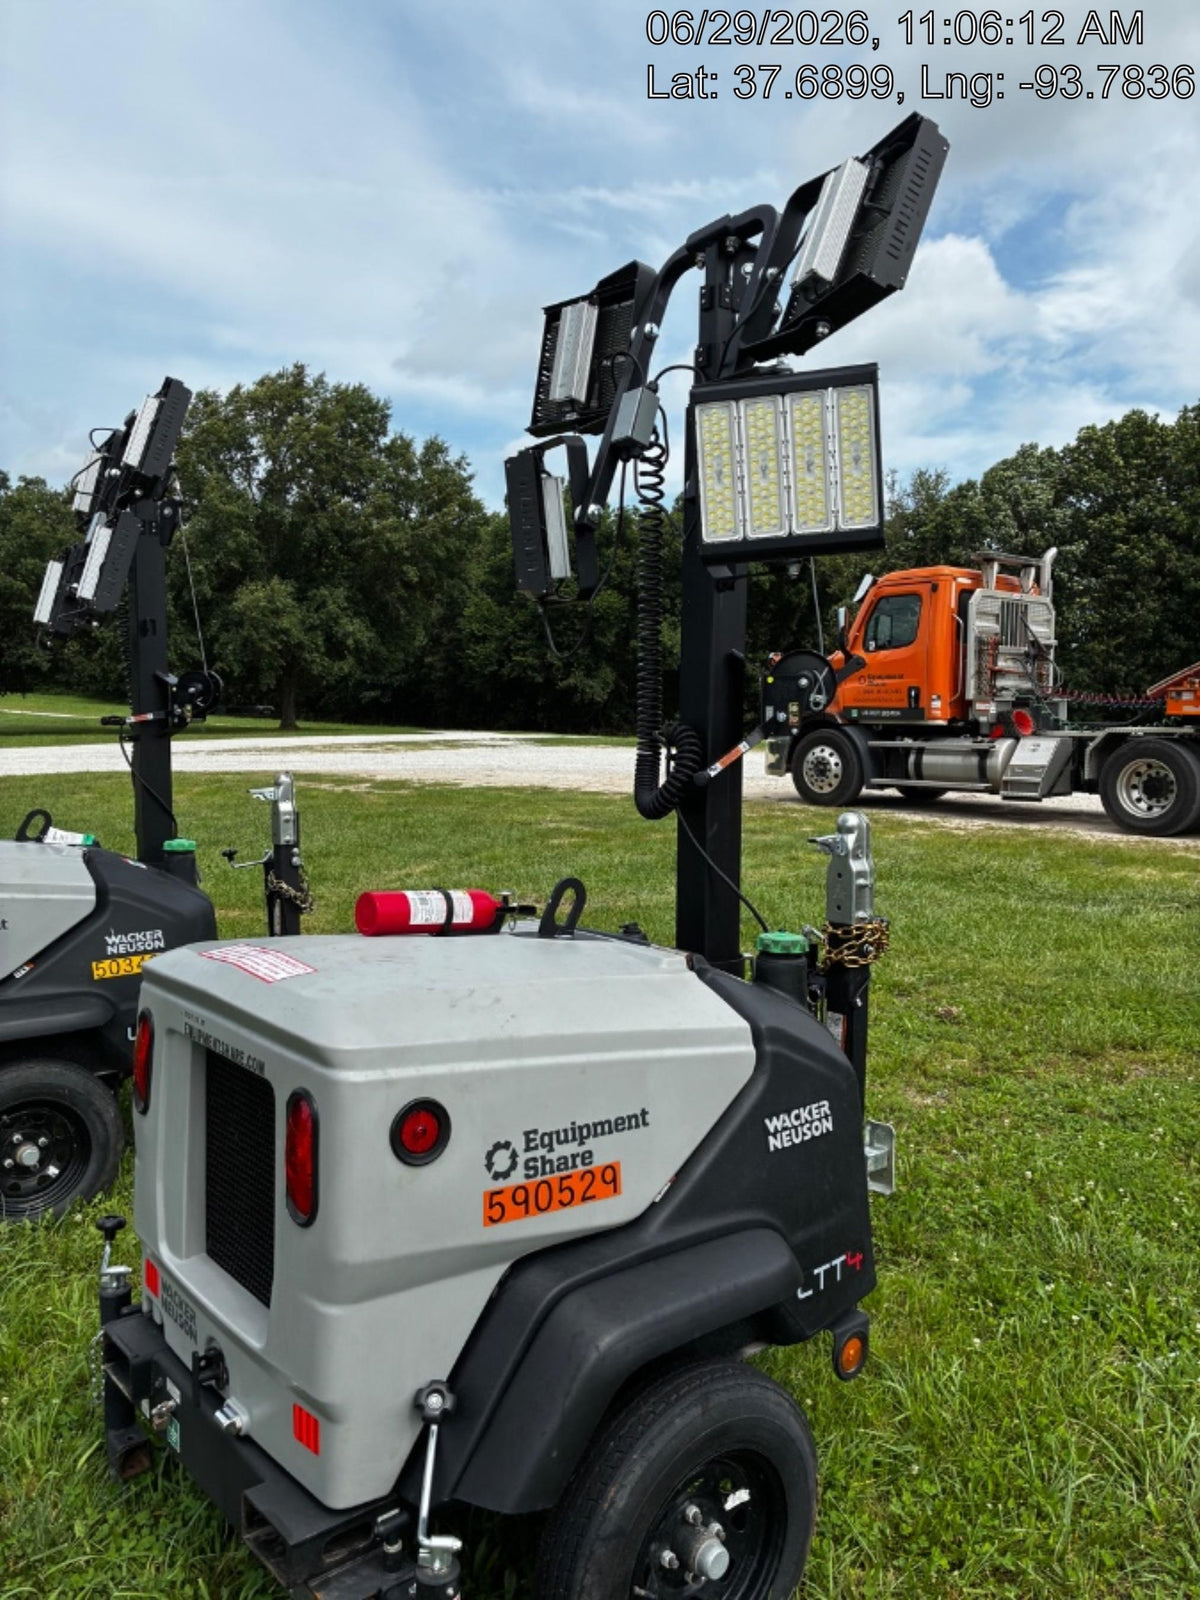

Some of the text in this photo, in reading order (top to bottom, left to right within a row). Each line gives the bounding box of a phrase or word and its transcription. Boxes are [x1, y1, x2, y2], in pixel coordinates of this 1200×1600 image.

[105, 928, 163, 945] WACKER
[106, 940, 165, 955] NEUSON
[95, 954, 157, 977] 503
[523, 1108, 650, 1153] Equipment
[764, 1100, 832, 1134] WACKER
[768, 1116, 834, 1152] NEUSON
[523, 1149, 594, 1180] Share
[487, 1164, 619, 1224] 590529
